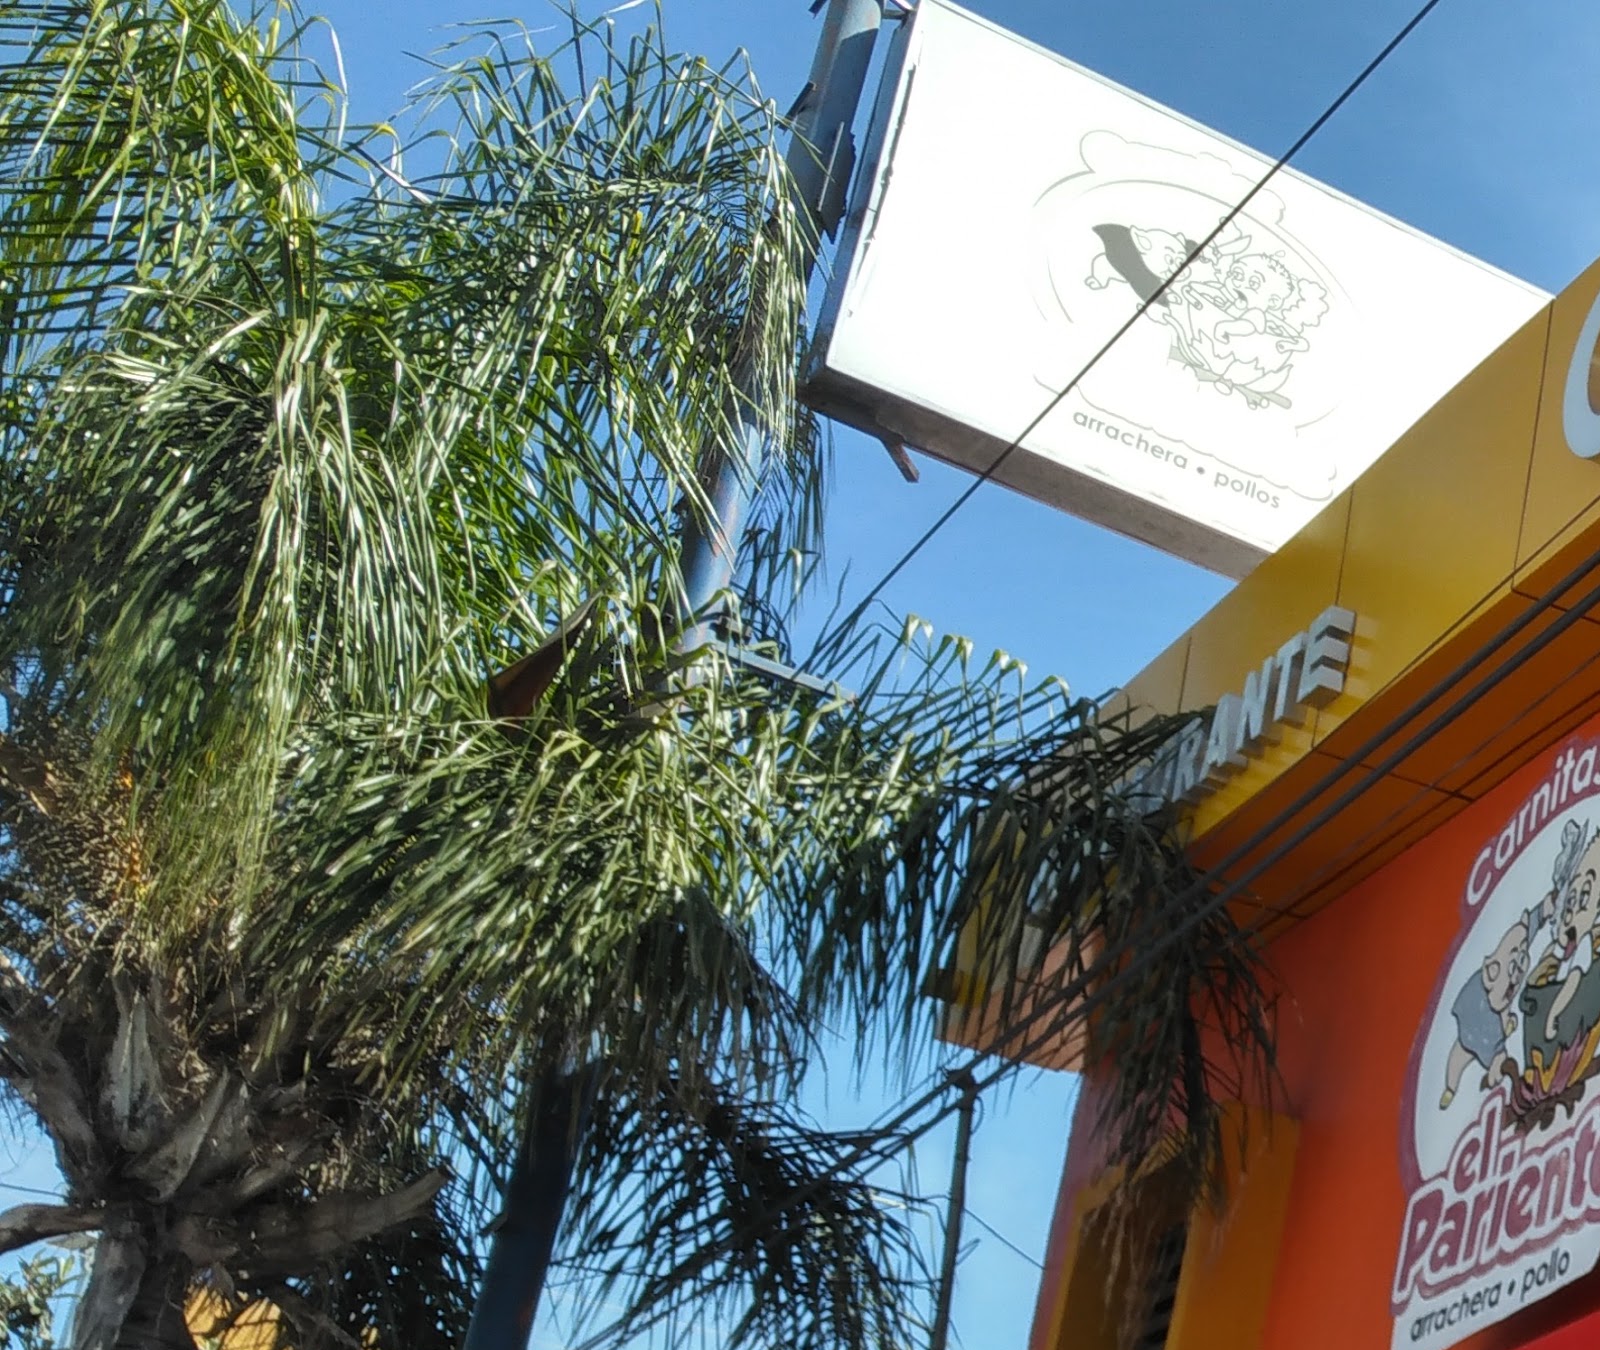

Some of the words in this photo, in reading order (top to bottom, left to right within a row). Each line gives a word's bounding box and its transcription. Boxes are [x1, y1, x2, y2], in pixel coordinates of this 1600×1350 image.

[1073, 407, 1188, 471] arrachera
[1214, 469, 1281, 509] pollos
[1410, 1276, 1502, 1343] arrachera
[1519, 1248, 1571, 1311] pollo
